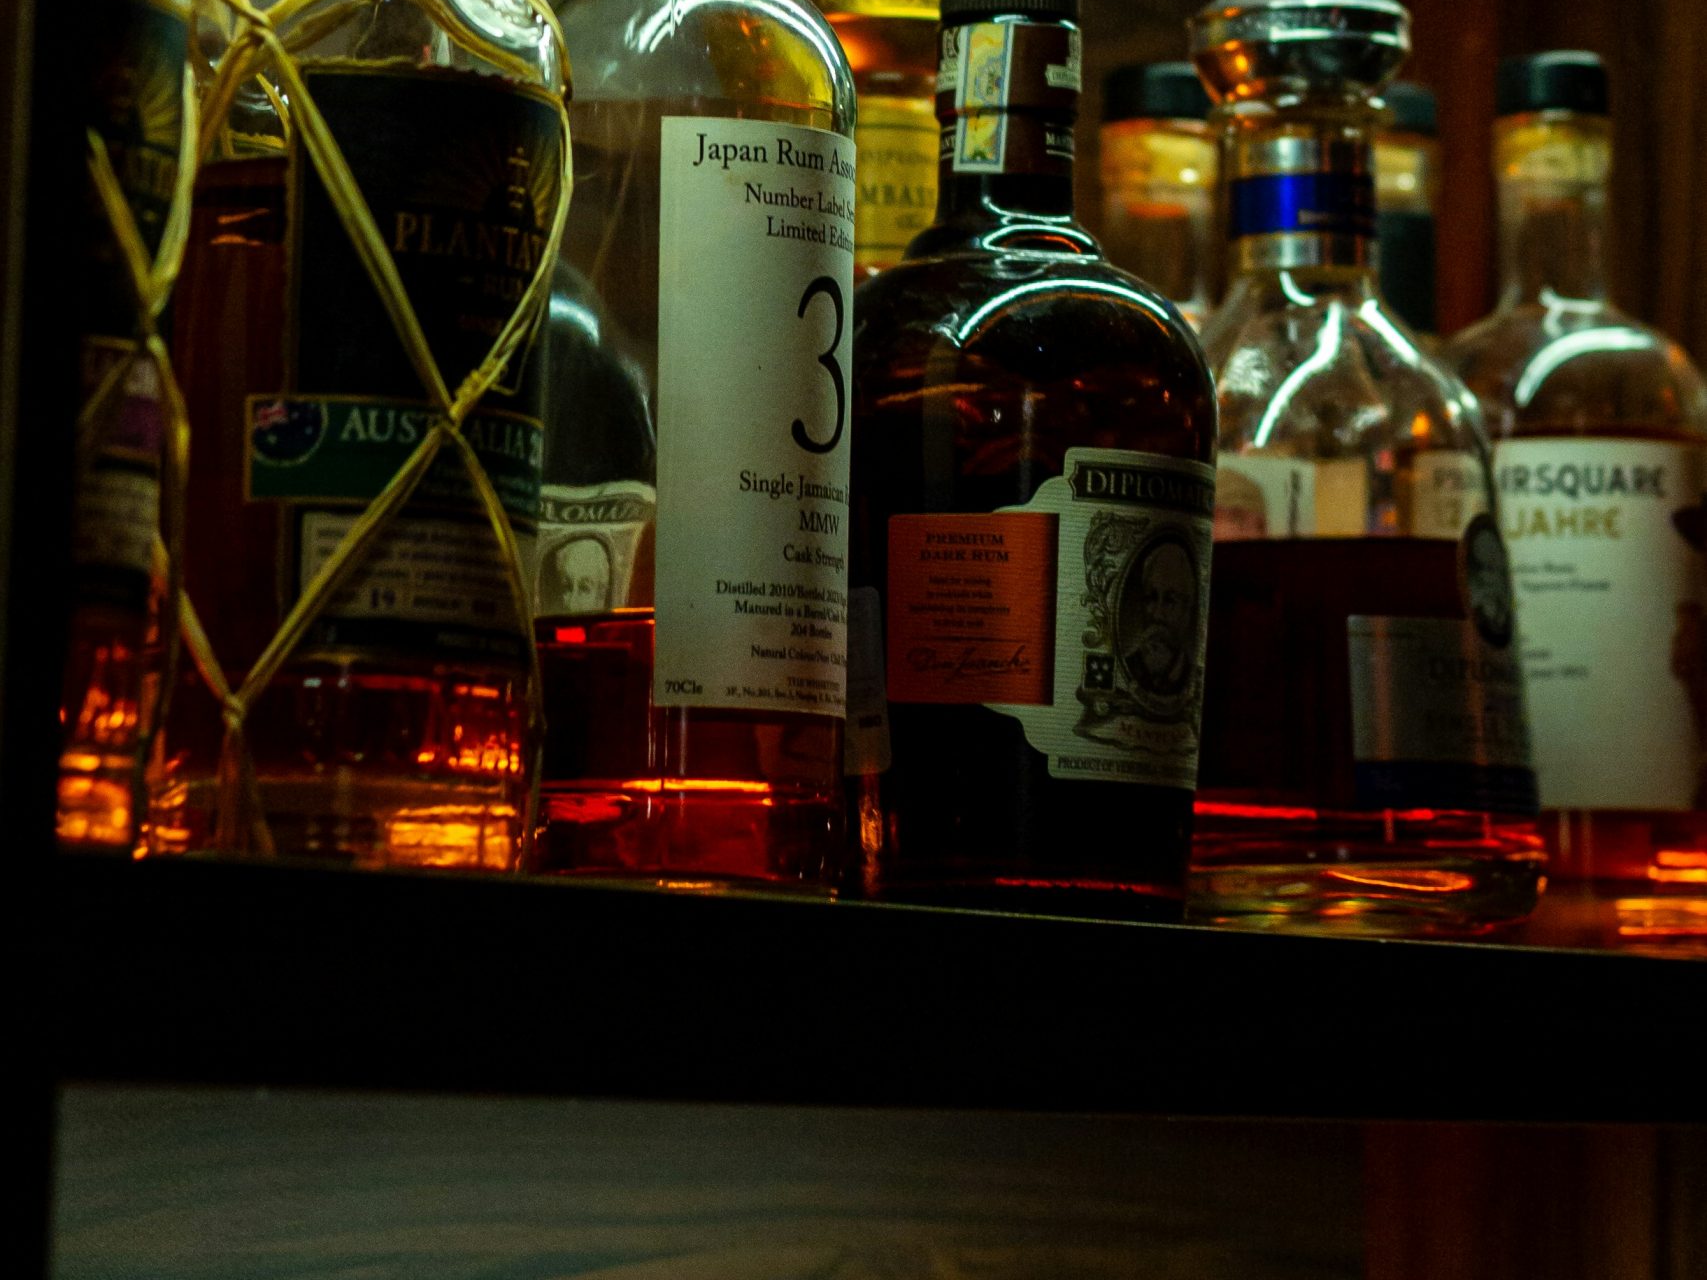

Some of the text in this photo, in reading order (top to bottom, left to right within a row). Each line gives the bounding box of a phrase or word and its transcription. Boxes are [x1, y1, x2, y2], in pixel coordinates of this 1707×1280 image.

[692, 132, 768, 169] Japan
[776, 138, 825, 171] Rum
[744, 182, 814, 211] Number
[818, 191, 845, 220] Label
[766, 215, 826, 245] Limited
[790, 275, 846, 455] 3
[739, 469, 794, 500] Single
[799, 509, 840, 536] MMW
[926, 533, 1005, 545] PREMIUM
[783, 543, 813, 564] Cask
[920, 549, 1009, 562] DARK RUM
[716, 579, 766, 596] Distilled
[734, 600, 782, 616] Matured
[751, 644, 787, 659] Natural
